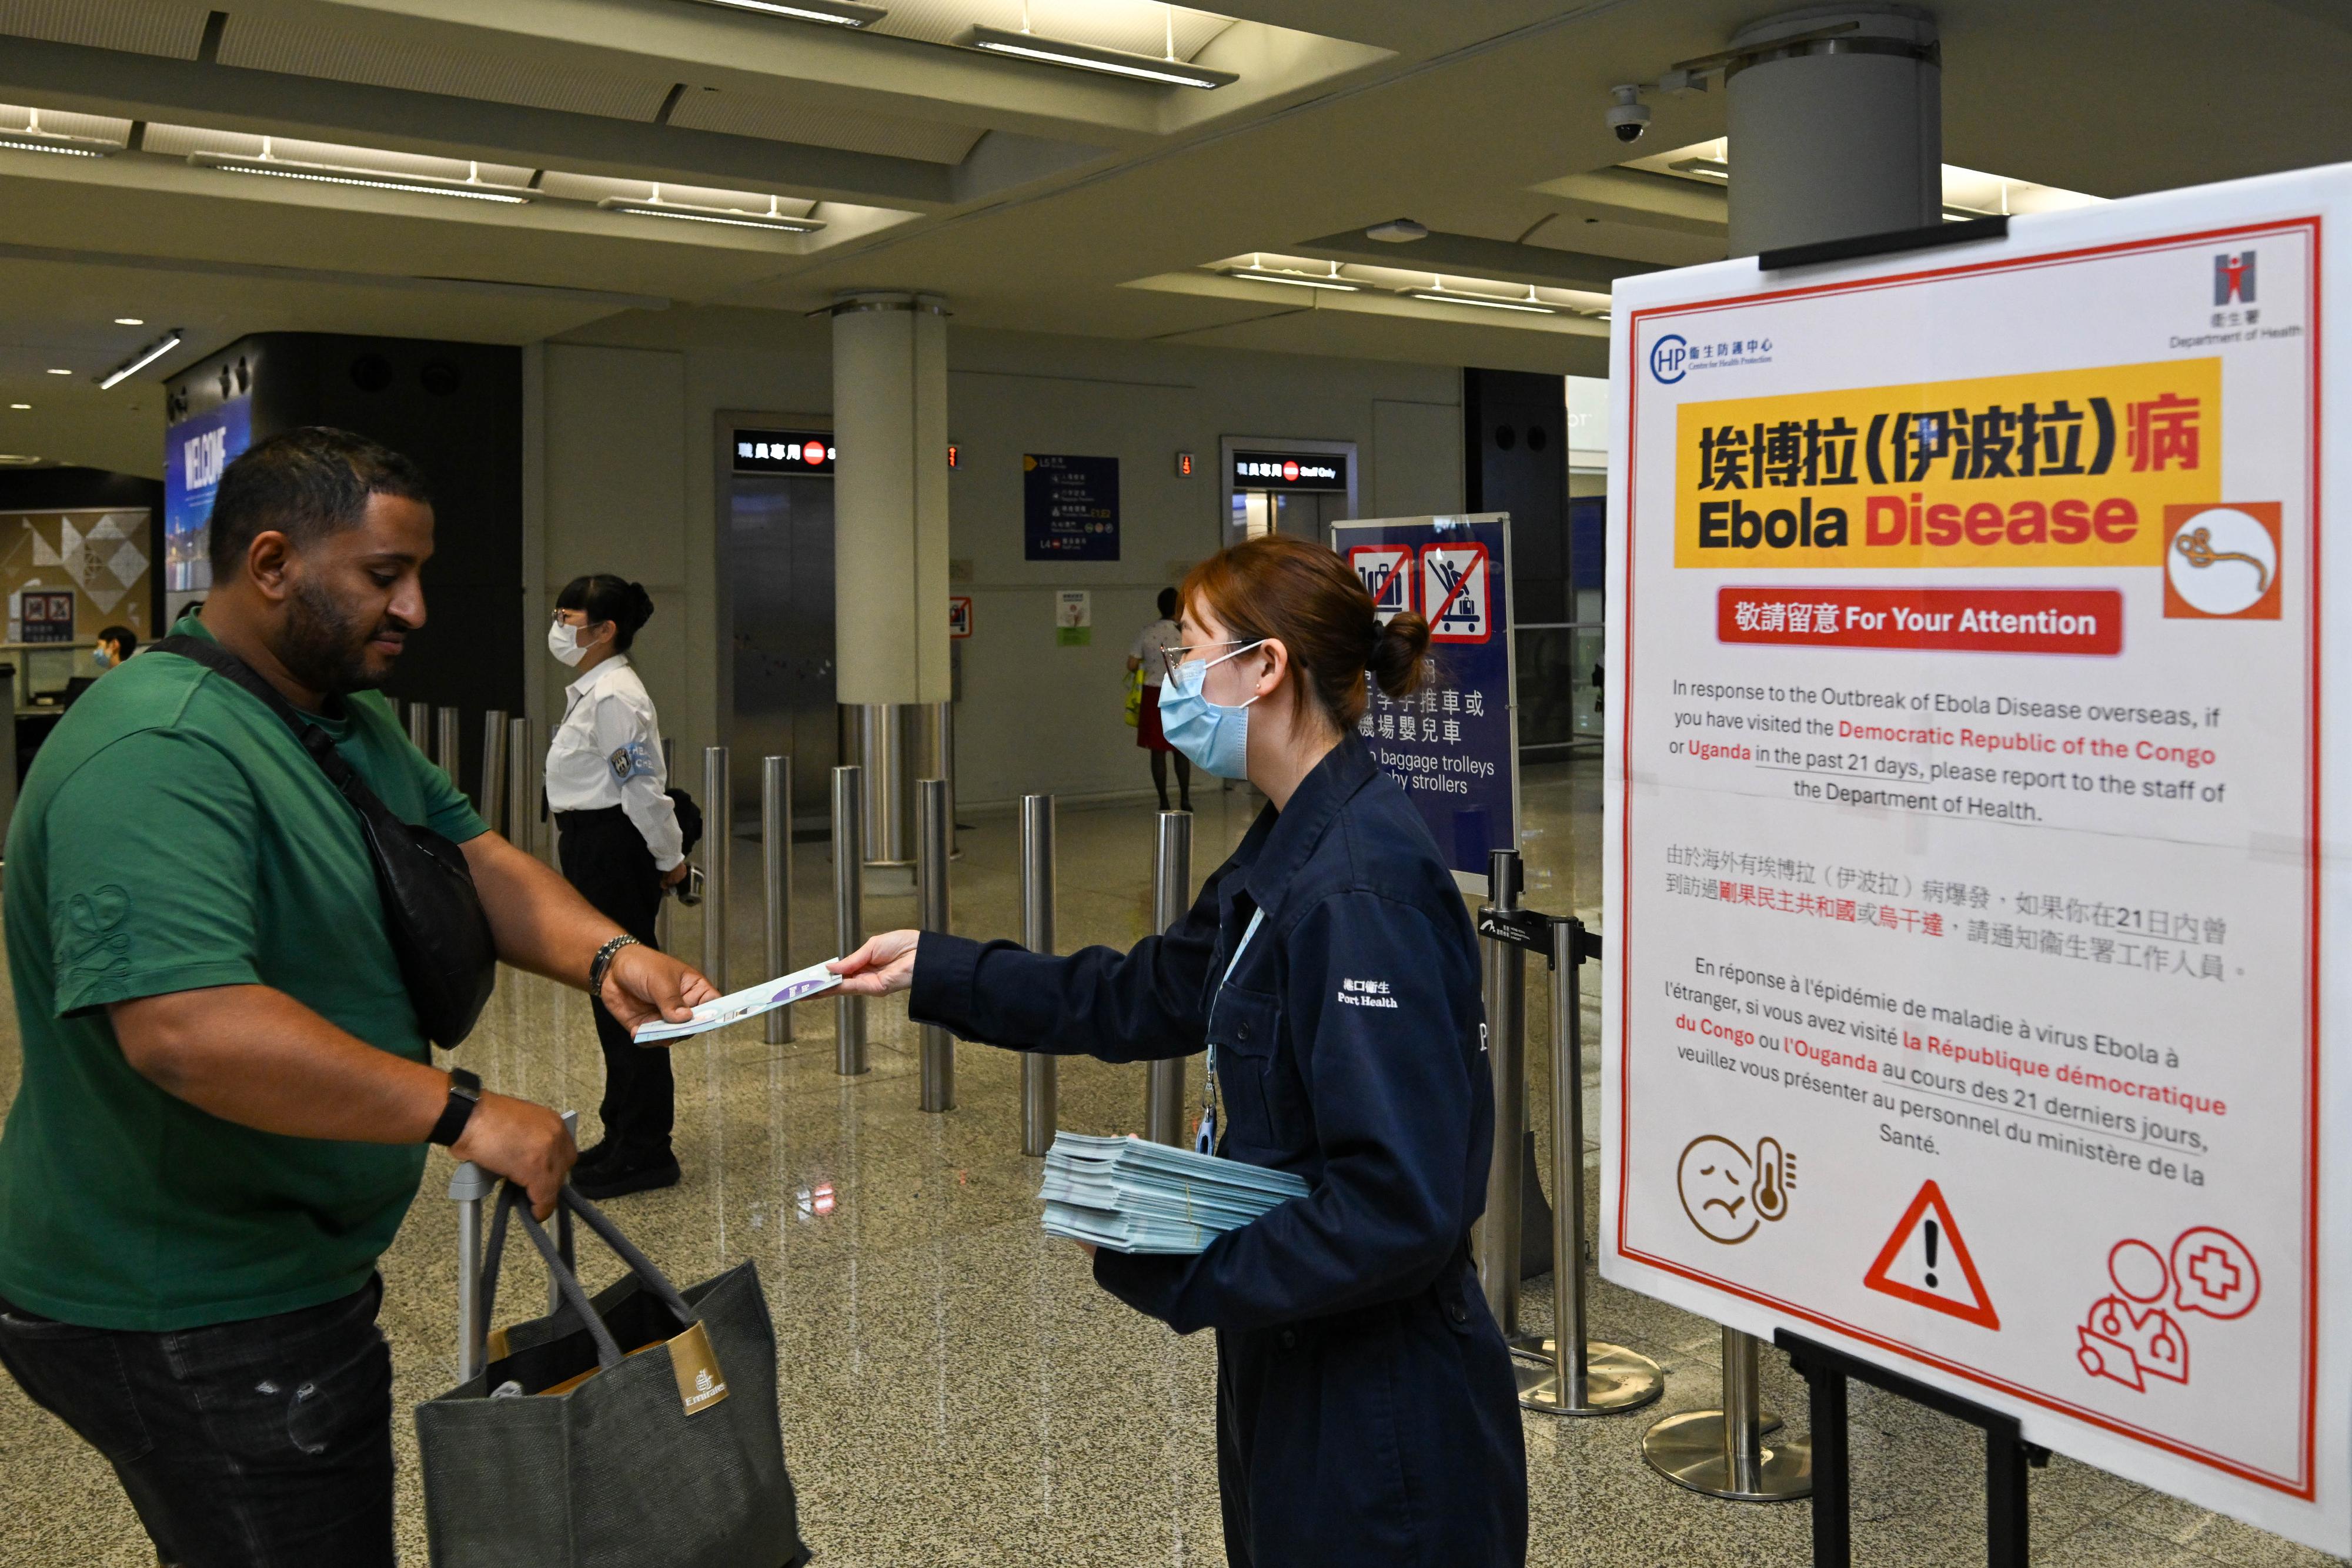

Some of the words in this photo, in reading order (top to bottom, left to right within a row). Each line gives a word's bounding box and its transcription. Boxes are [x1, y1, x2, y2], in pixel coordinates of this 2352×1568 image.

[2170, 332, 2241, 349] Department
[2244, 329, 2259, 342] of
[2260, 325, 2302, 339] Health
[1688, 362, 1708, 370] Centre
[1719, 359, 1739, 367] Health
[1741, 356, 1772, 365] Protection
[1698, 497, 1848, 550] Ebola
[1865, 492, 2139, 547] Disease
[1735, 601, 1840, 635] 敬請留意
[1845, 607, 1887, 631] For
[1892, 608, 1953, 634] Your
[1958, 608, 2096, 637] Attention
[1673, 680, 1686, 696] In
[1691, 682, 1764, 701] response
[1769, 686, 1785, 701] to
[1790, 686, 1817, 703] the
[1822, 688, 1906, 709] Outbreak
[1912, 694, 1930, 710] of
[1935, 694, 1990, 714] Ebola
[1997, 697, 2082, 720] Disease
[2088, 705, 2197, 728] overseas,
[2205, 708, 2221, 727] if
[1675, 711, 1702, 728] you
[1706, 711, 1743, 729] have
[1747, 715, 1801, 734] visited
[1806, 718, 1833, 736] the
[1839, 721, 1953, 745] Democratic
[1960, 728, 2056, 753] Republic
[2063, 737, 2084, 755] of
[2091, 738, 2129, 759] the
[2136, 741, 2217, 768] Congo
[1381, 748, 1438, 773] baggage
[1442, 755, 1494, 778] trolleys
[1669, 740, 1686, 754] or
[1688, 740, 1750, 760] Uganda
[1756, 745, 1770, 761] in
[1774, 747, 1801, 765] the
[1806, 752, 1843, 770] past
[1848, 754, 1868, 771] 21
[1875, 757, 1925, 779] days,
[1930, 761, 1996, 783] please
[2002, 768, 2066, 790] report
[2072, 773, 2093, 791] to
[2099, 775, 2136, 795] the
[2143, 780, 2196, 801] staff
[2201, 784, 2226, 803] of
[1412, 774, 1467, 794] strollers
[1793, 781, 1821, 798] the
[1826, 783, 1938, 811] Department
[1943, 795, 1962, 814] of
[1967, 797, 2043, 822] Health.
[1338, 992, 1359, 1006] Port
[1361, 996, 1398, 1008] Health
[1696, 957, 1715, 975] En
[1719, 962, 1785, 990] réponse
[1790, 975, 1800, 993] à
[1805, 978, 1897, 1012] l'épidémie
[1903, 999, 1926, 1018] de
[1932, 1005, 2013, 1035] maladie
[2019, 1019, 2030, 1039] à
[2036, 1025, 2087, 1051] virus
[2094, 1035, 2159, 1065] Ebola
[2166, 1048, 2180, 1068] à
[1665, 981, 1740, 1014] l'étranger,
[1746, 999, 1759, 1015] si
[1763, 1005, 1803, 1025] vous
[1808, 1013, 1846, 1035] avez
[1850, 1020, 1898, 1046] visité
[1903, 1031, 1921, 1051] la
[1928, 1035, 2050, 1078] République
[2056, 1065, 2227, 1116] démocratique
[1676, 1014, 1695, 1032] du
[1700, 1019, 1755, 1047] Congo
[1759, 1034, 1780, 1051] ou
[1784, 1037, 1877, 1074] l'Ouganda
[1883, 1062, 1905, 1080] au
[1910, 1069, 1966, 1094] cours
[1972, 1081, 2007, 1104] des
[2013, 1089, 2037, 1110] 21
[2044, 1098, 2136, 1134] derniers
[2140, 1118, 2208, 1153] jours,
[1678, 1045, 1736, 1072] veuillez
[1740, 1060, 1780, 1082] vous
[1784, 1071, 1868, 1104] présenter
[1873, 1092, 1895, 1111] au
[1900, 1099, 1999, 1138] personnel
[2005, 1122, 2032, 1145] du
[2037, 1130, 2141, 1172] ministère
[2147, 1157, 2177, 1181] de
[2183, 1164, 2205, 1187] la
[1880, 1122, 1940, 1156] Santé.
[685, 1383, 726, 1407] Emirates
